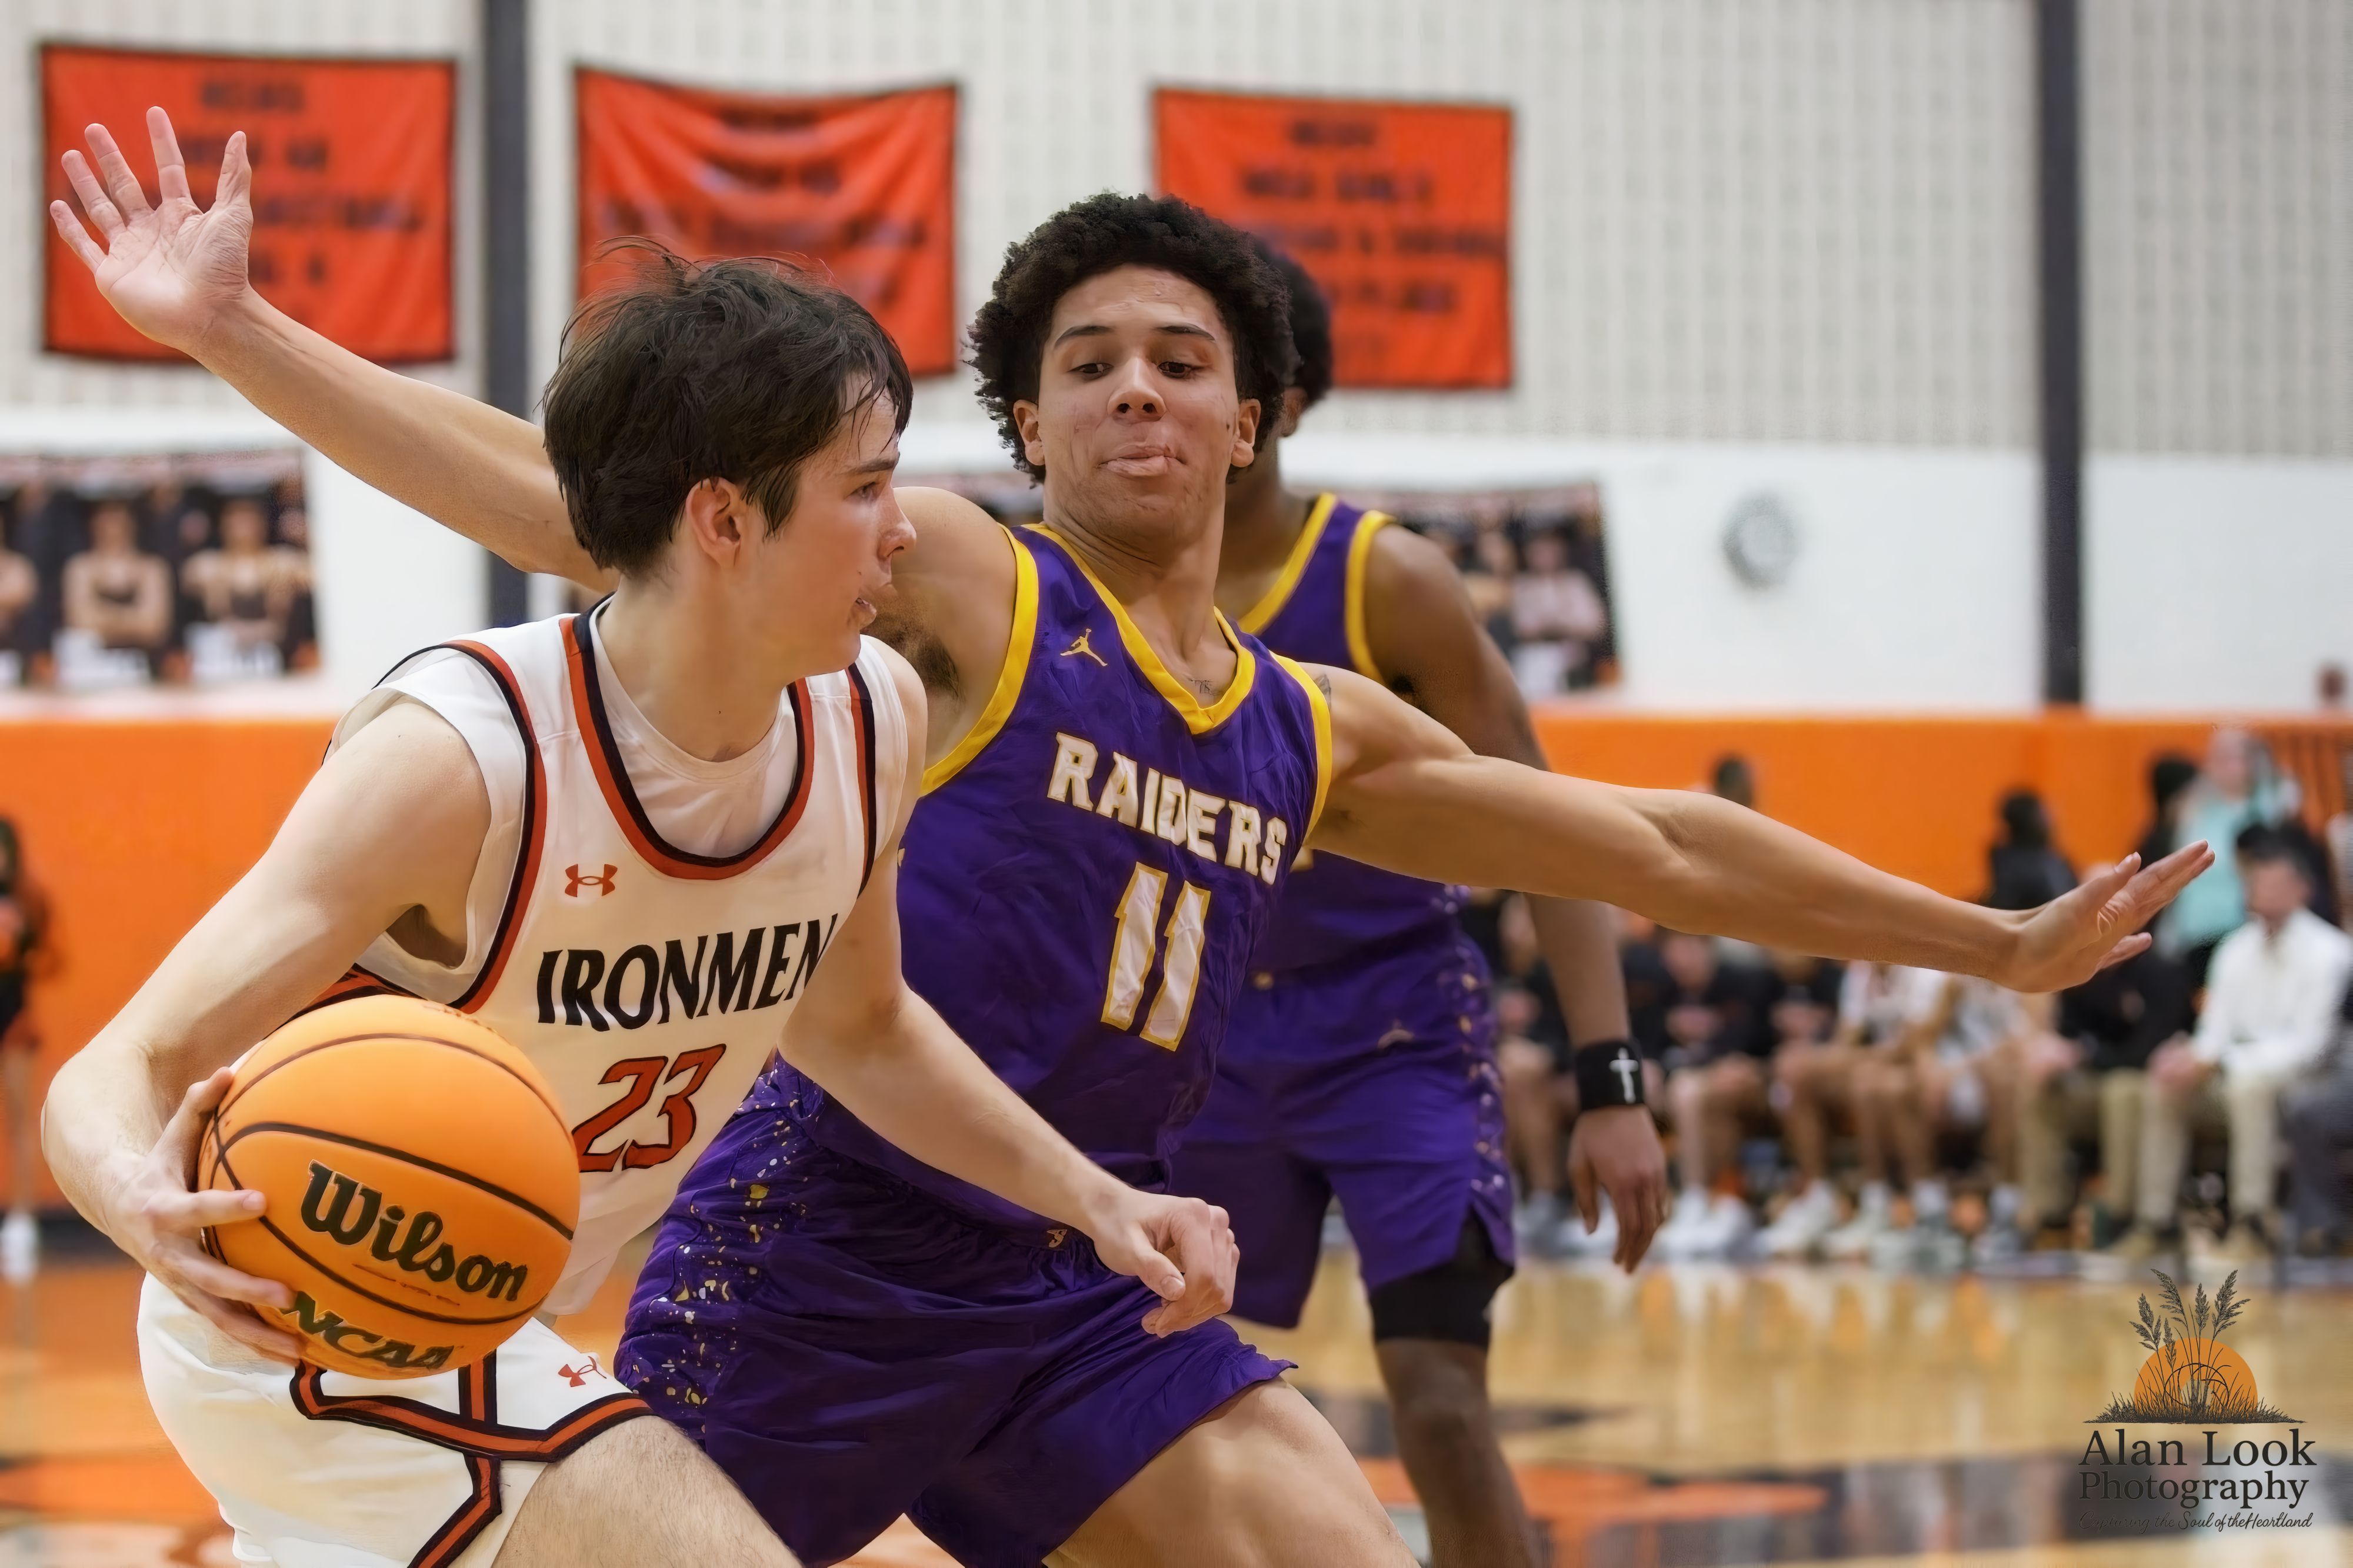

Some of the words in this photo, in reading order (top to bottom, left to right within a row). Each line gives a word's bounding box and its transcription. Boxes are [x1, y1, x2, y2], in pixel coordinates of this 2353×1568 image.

[1047, 732, 1287, 885] RAIDERS
[537, 913, 838, 1032] IRONMEN
[1101, 862, 1211, 1052] 11
[572, 1043, 726, 1172] 23
[301, 1160, 527, 1302] Wilson
[281, 1291, 454, 1369] NCAA
